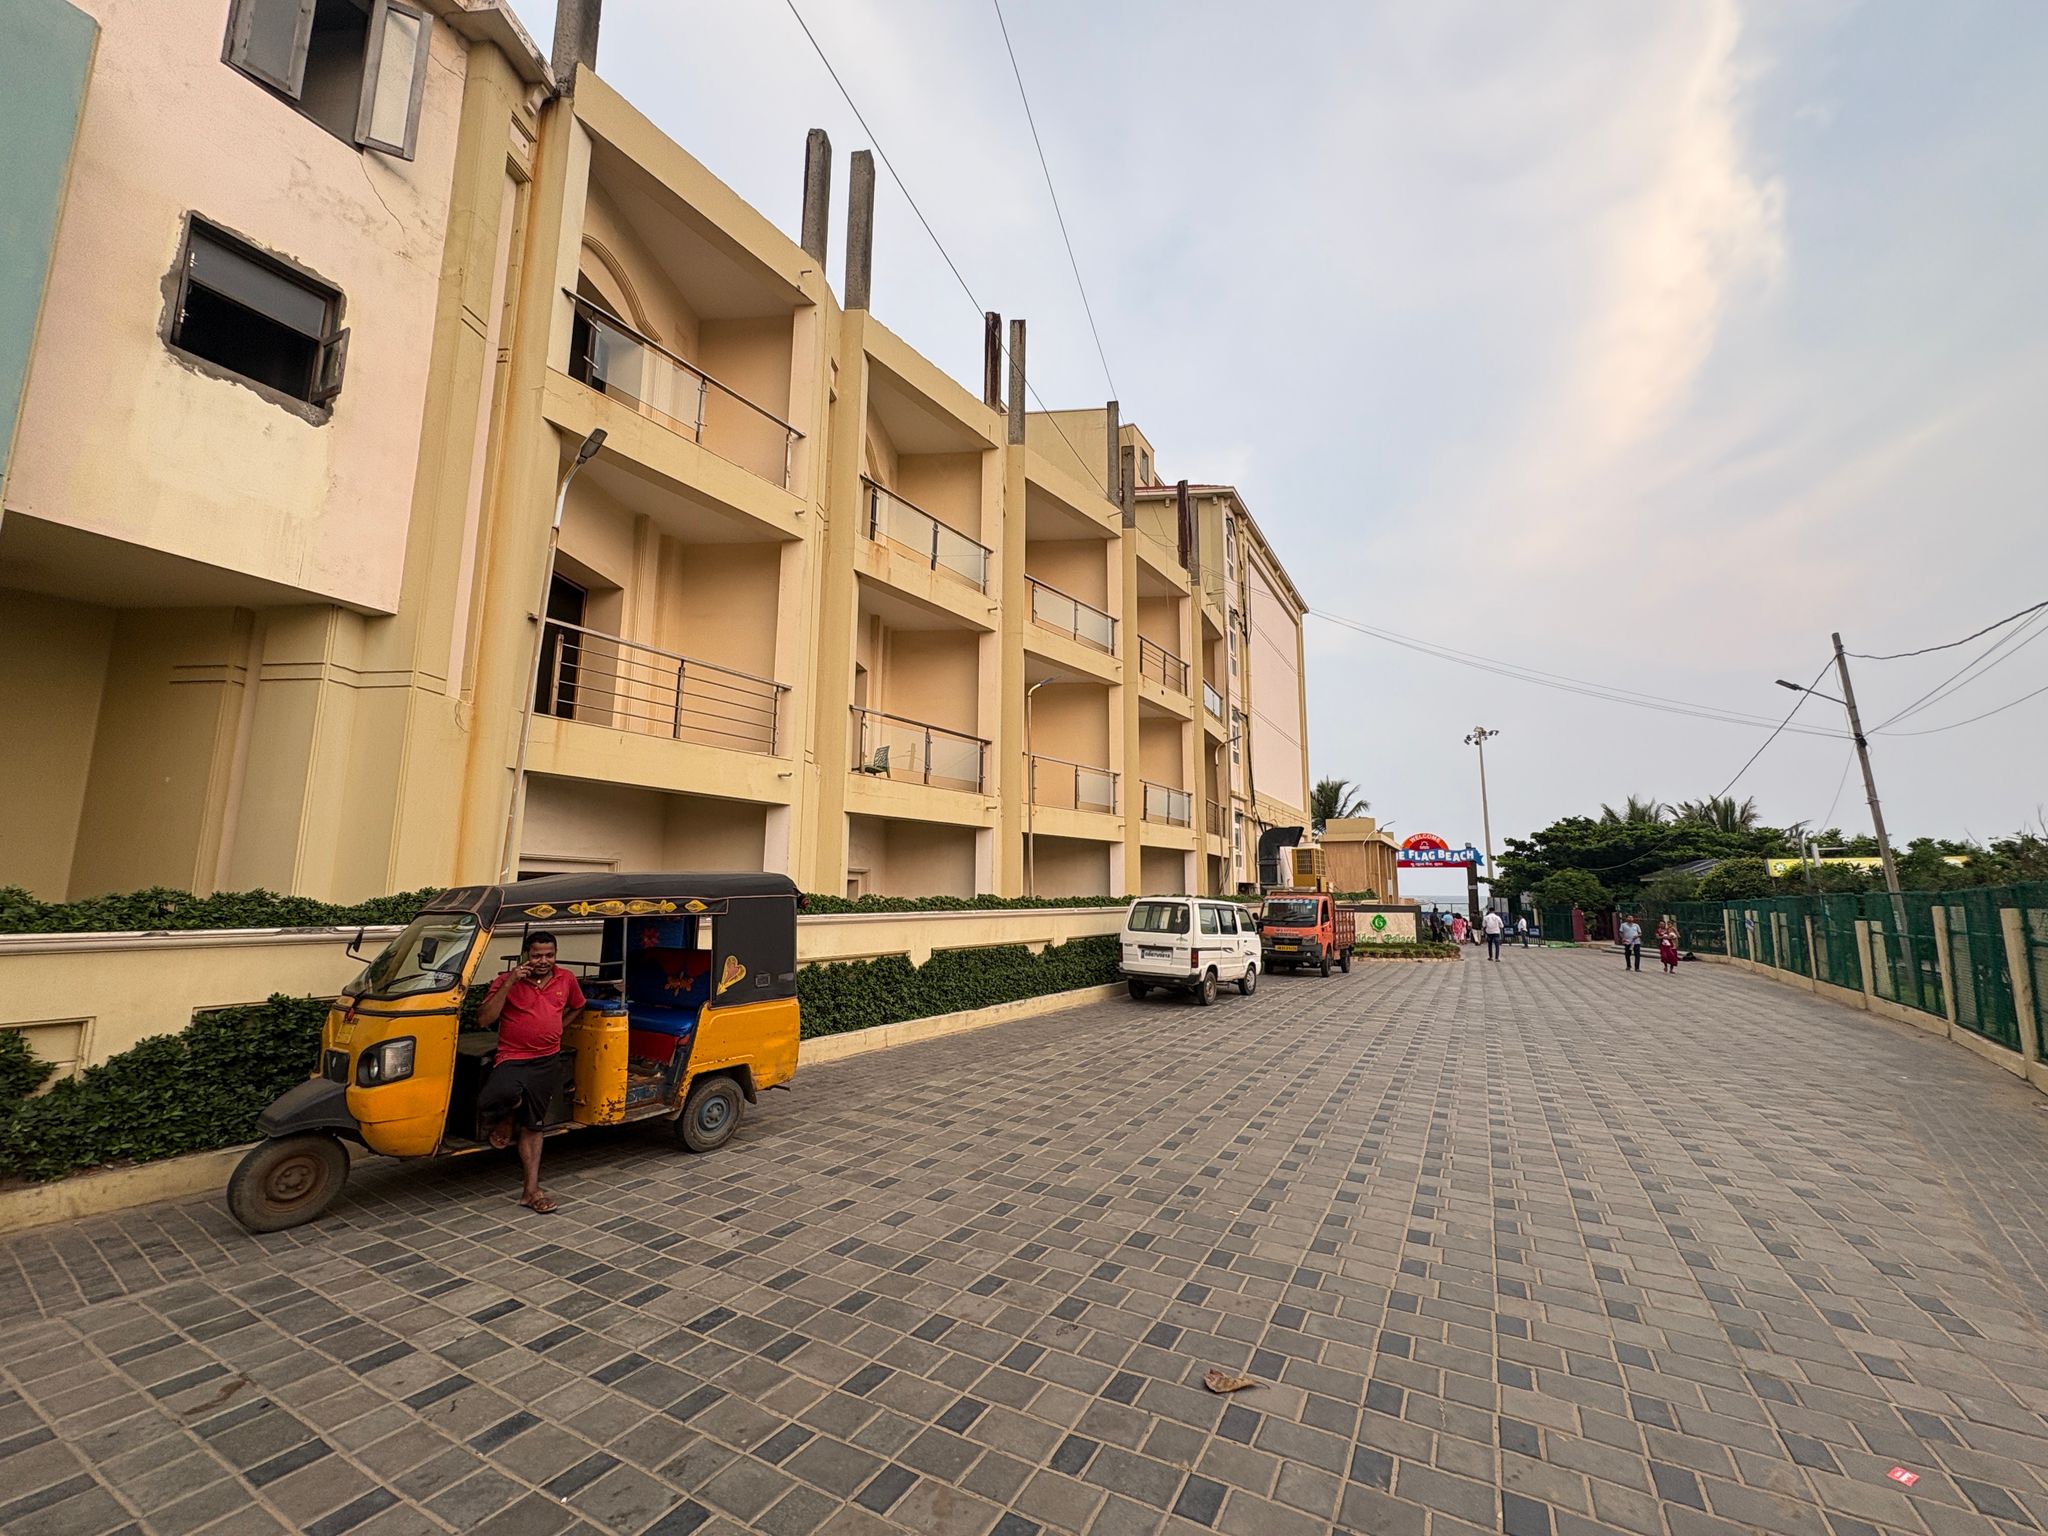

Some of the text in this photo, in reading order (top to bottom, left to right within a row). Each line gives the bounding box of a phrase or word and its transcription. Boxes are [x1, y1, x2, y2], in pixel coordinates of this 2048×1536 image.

[1410, 834, 1441, 844] WELCOME
[1408, 849, 1436, 861] FLAG
[1437, 849, 1474, 862] BEACH
[1384, 933, 1415, 944] Palace
